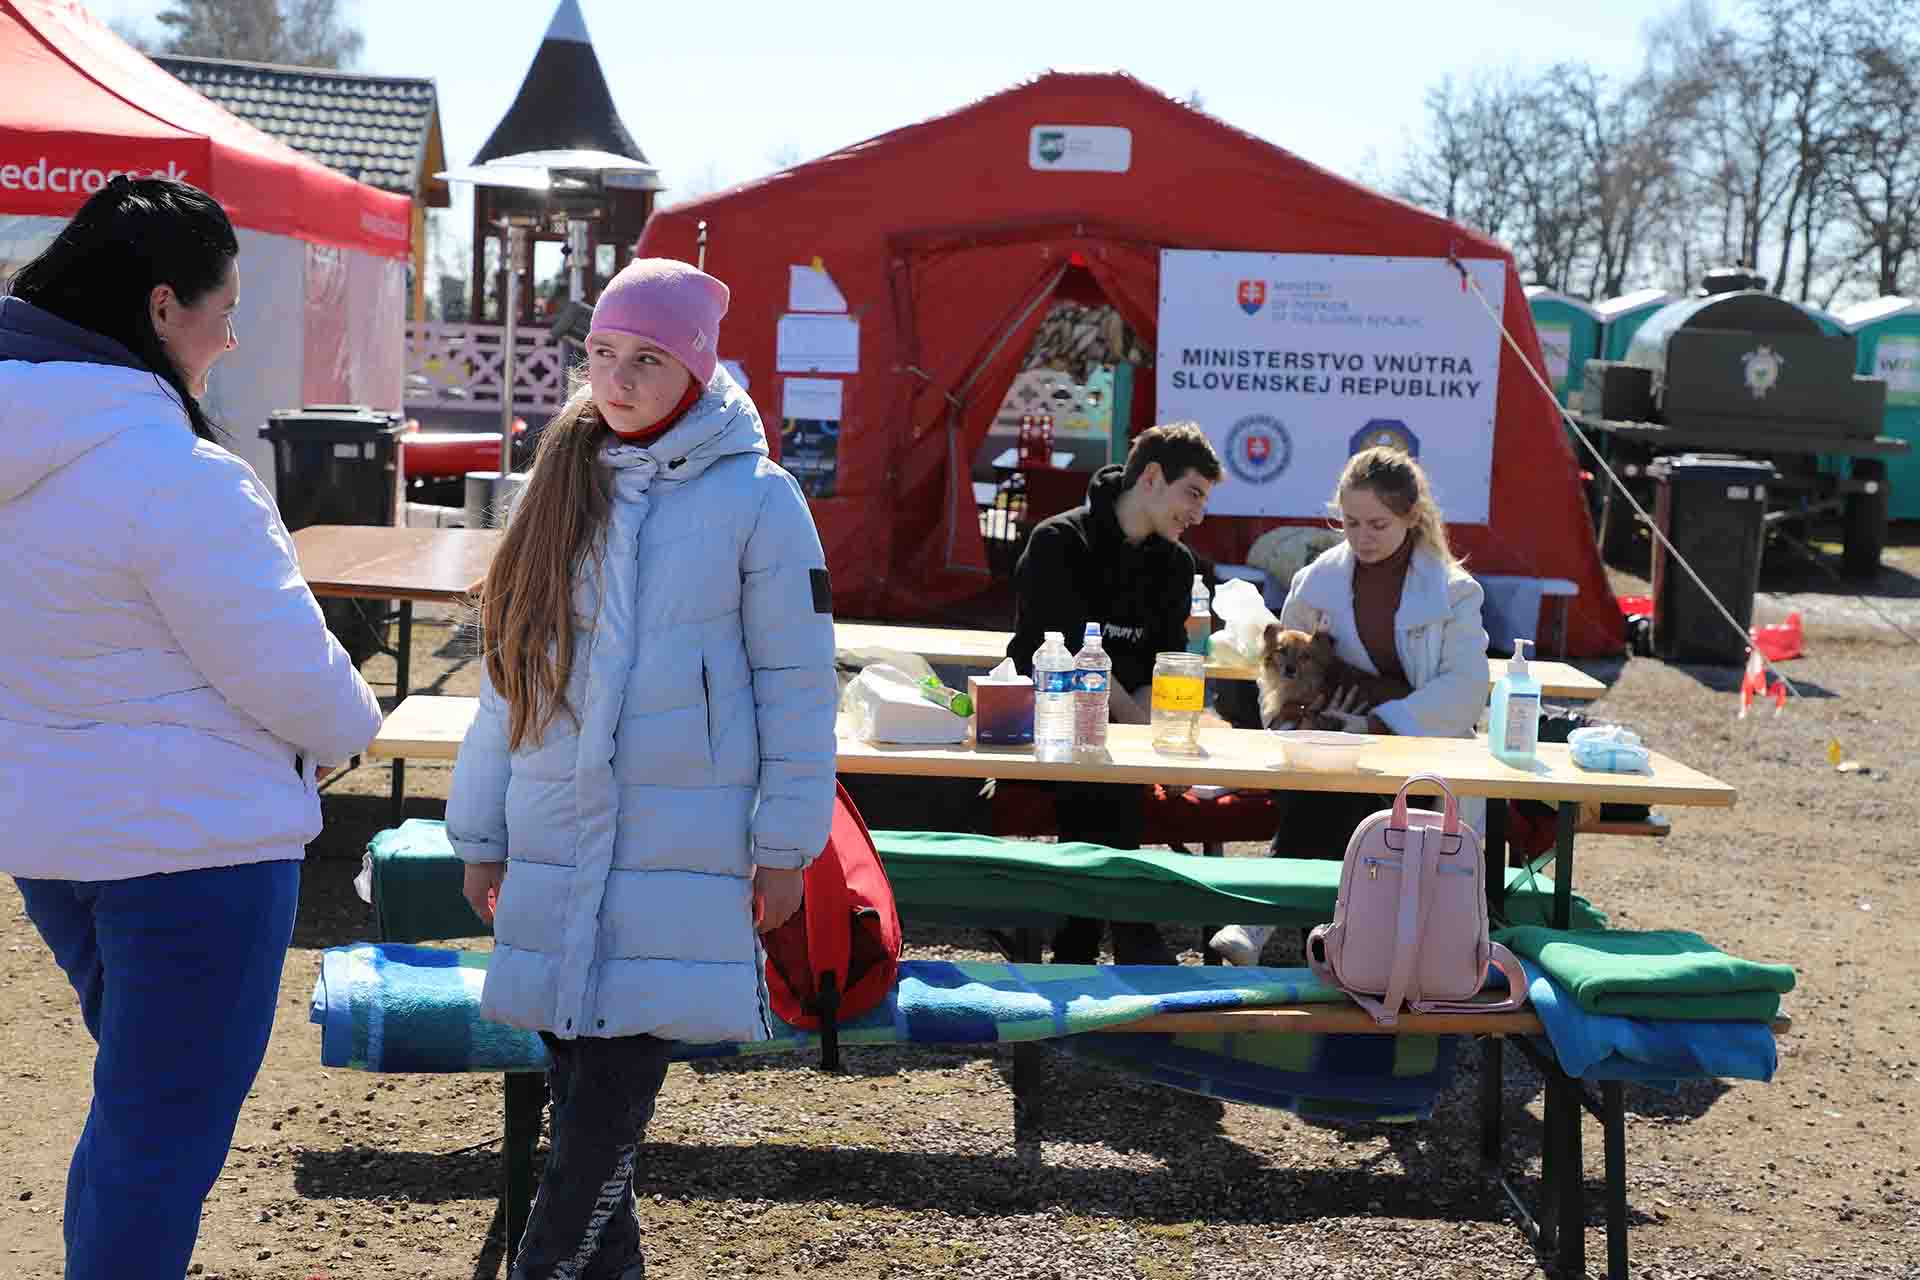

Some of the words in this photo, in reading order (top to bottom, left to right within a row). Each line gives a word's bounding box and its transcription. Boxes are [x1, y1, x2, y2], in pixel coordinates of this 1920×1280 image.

[1182, 348, 1364, 372] MINISTERSTVO
[1373, 351, 1473, 375] VNÚTRA
[1172, 370, 1332, 393] SLOVENSKEJ
[1341, 376, 1482, 399] REPUBLIKY
